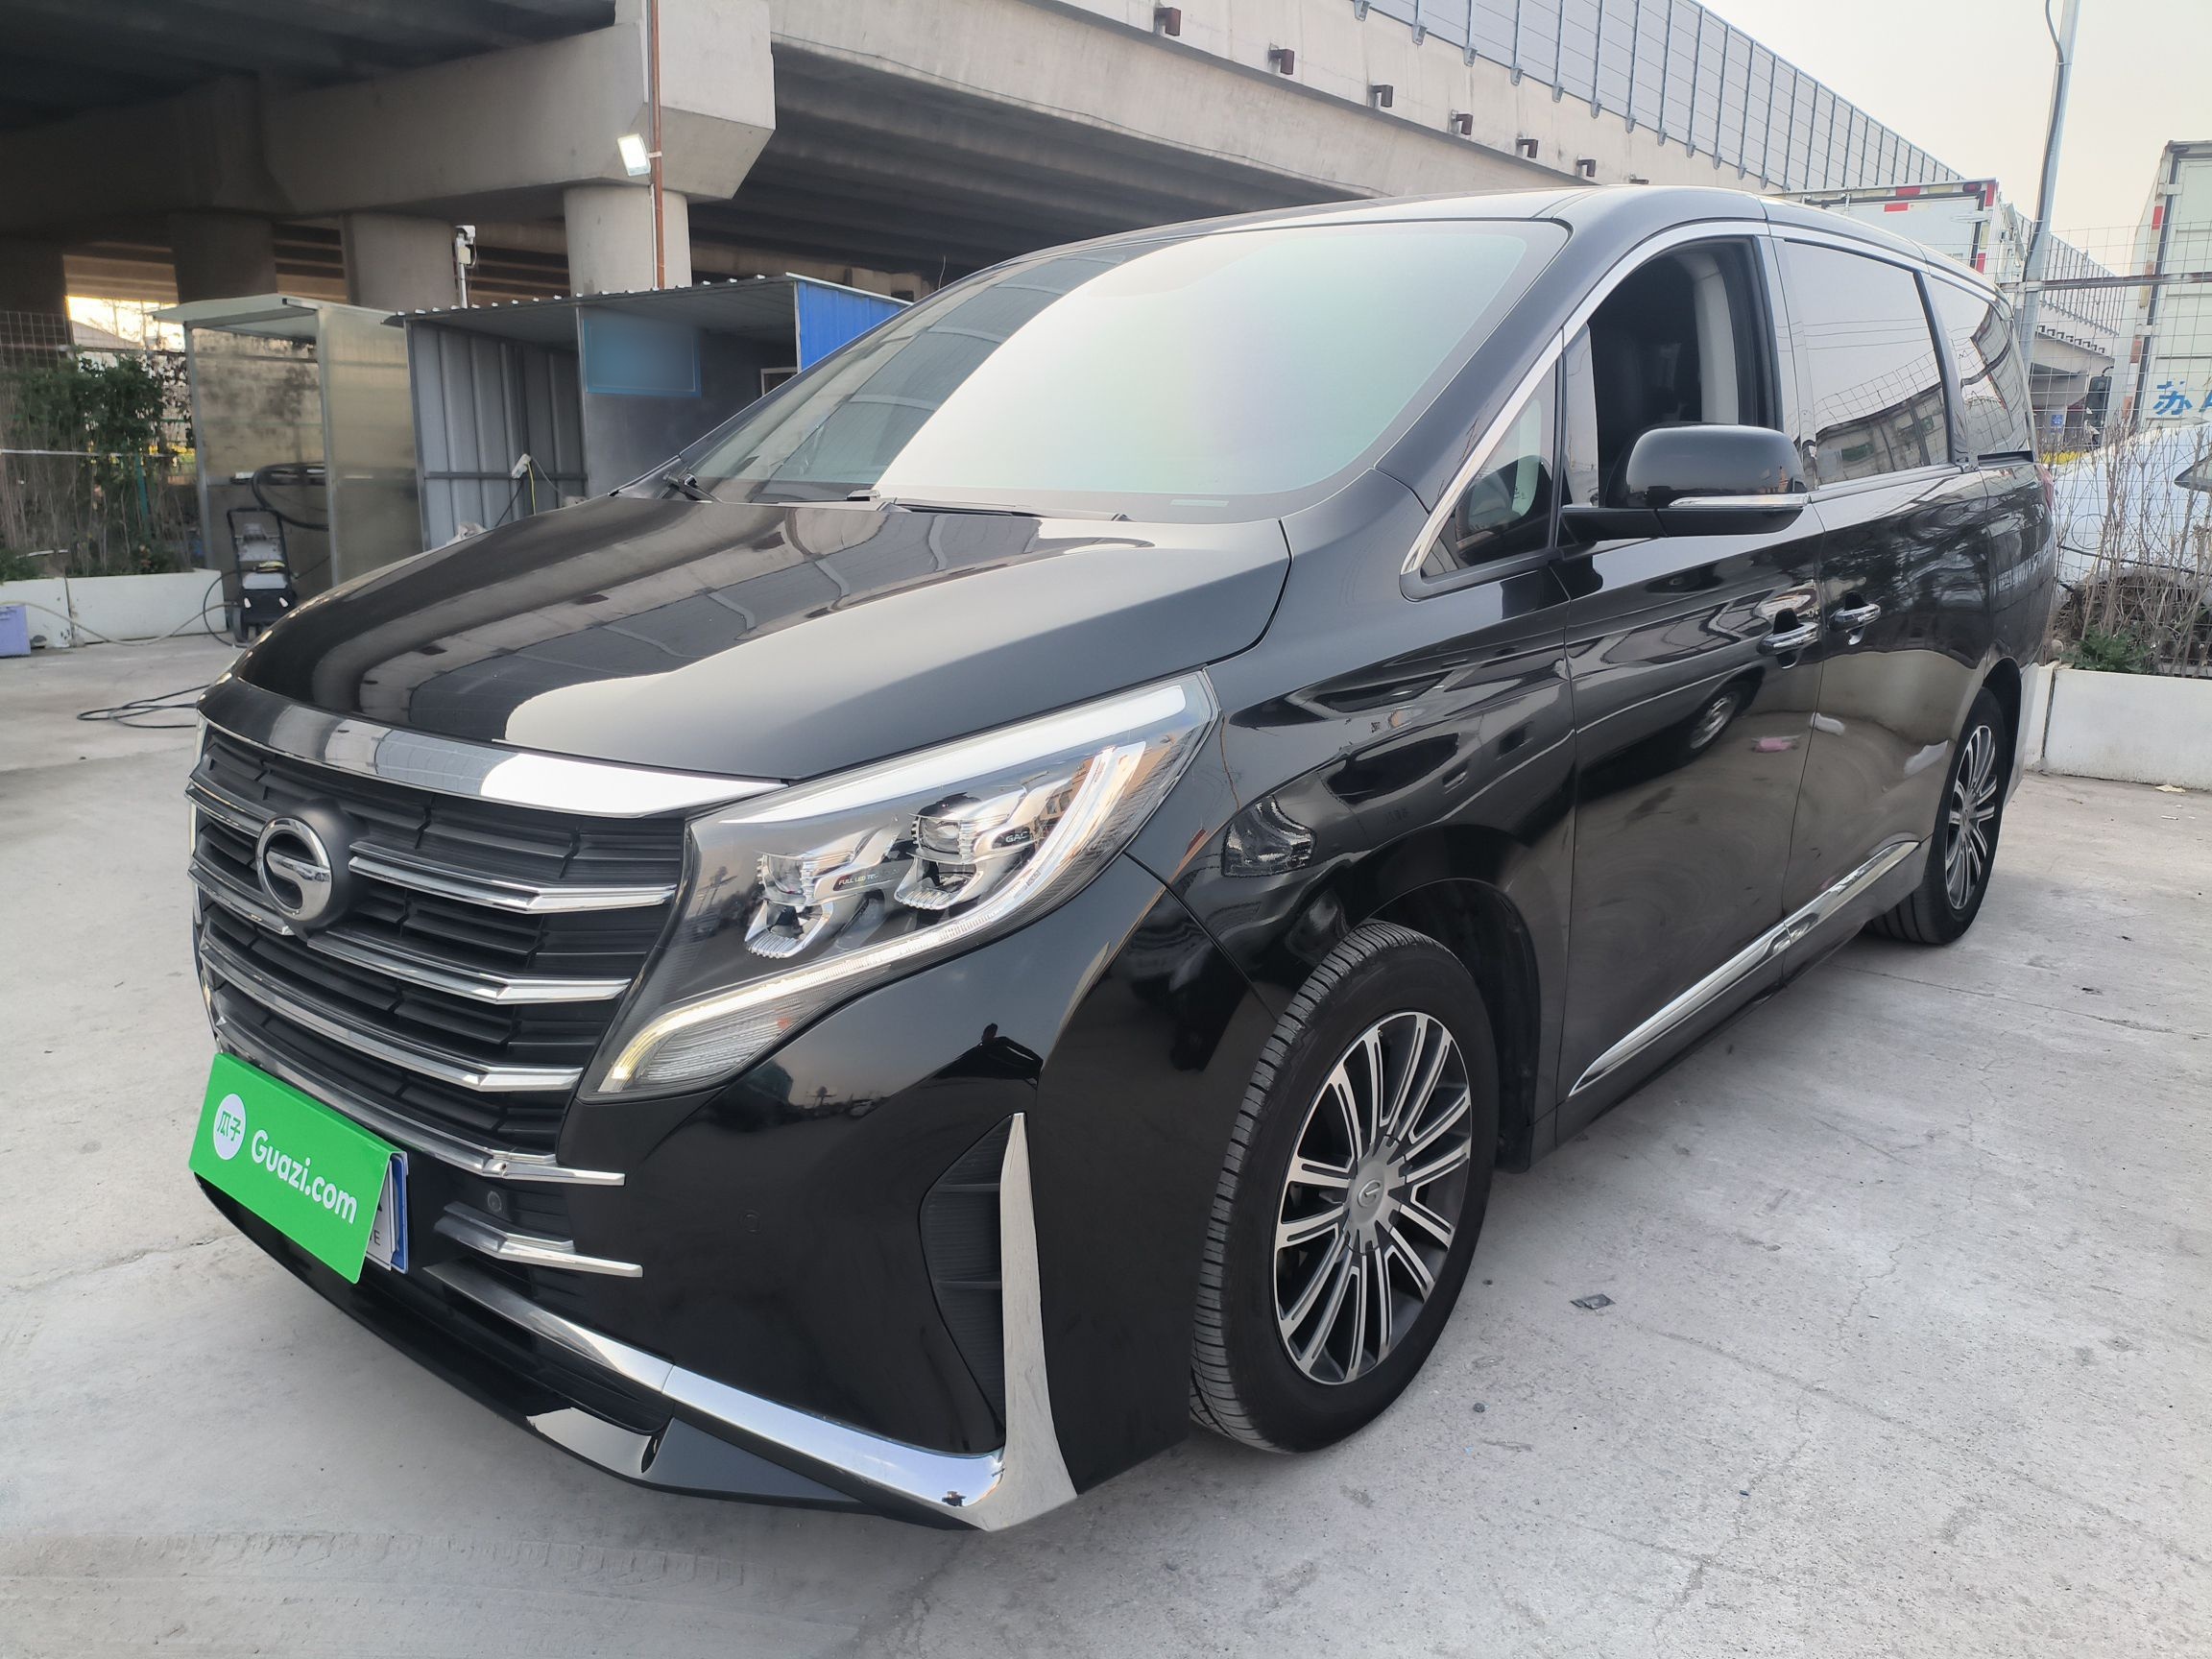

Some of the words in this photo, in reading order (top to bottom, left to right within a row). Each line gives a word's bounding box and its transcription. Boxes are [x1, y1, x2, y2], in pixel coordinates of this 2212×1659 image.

[1005, 830, 1029, 843] GAC
[217, 1110, 241, 1142] 瓜子
[251, 1129, 357, 1224] Guazi.com
